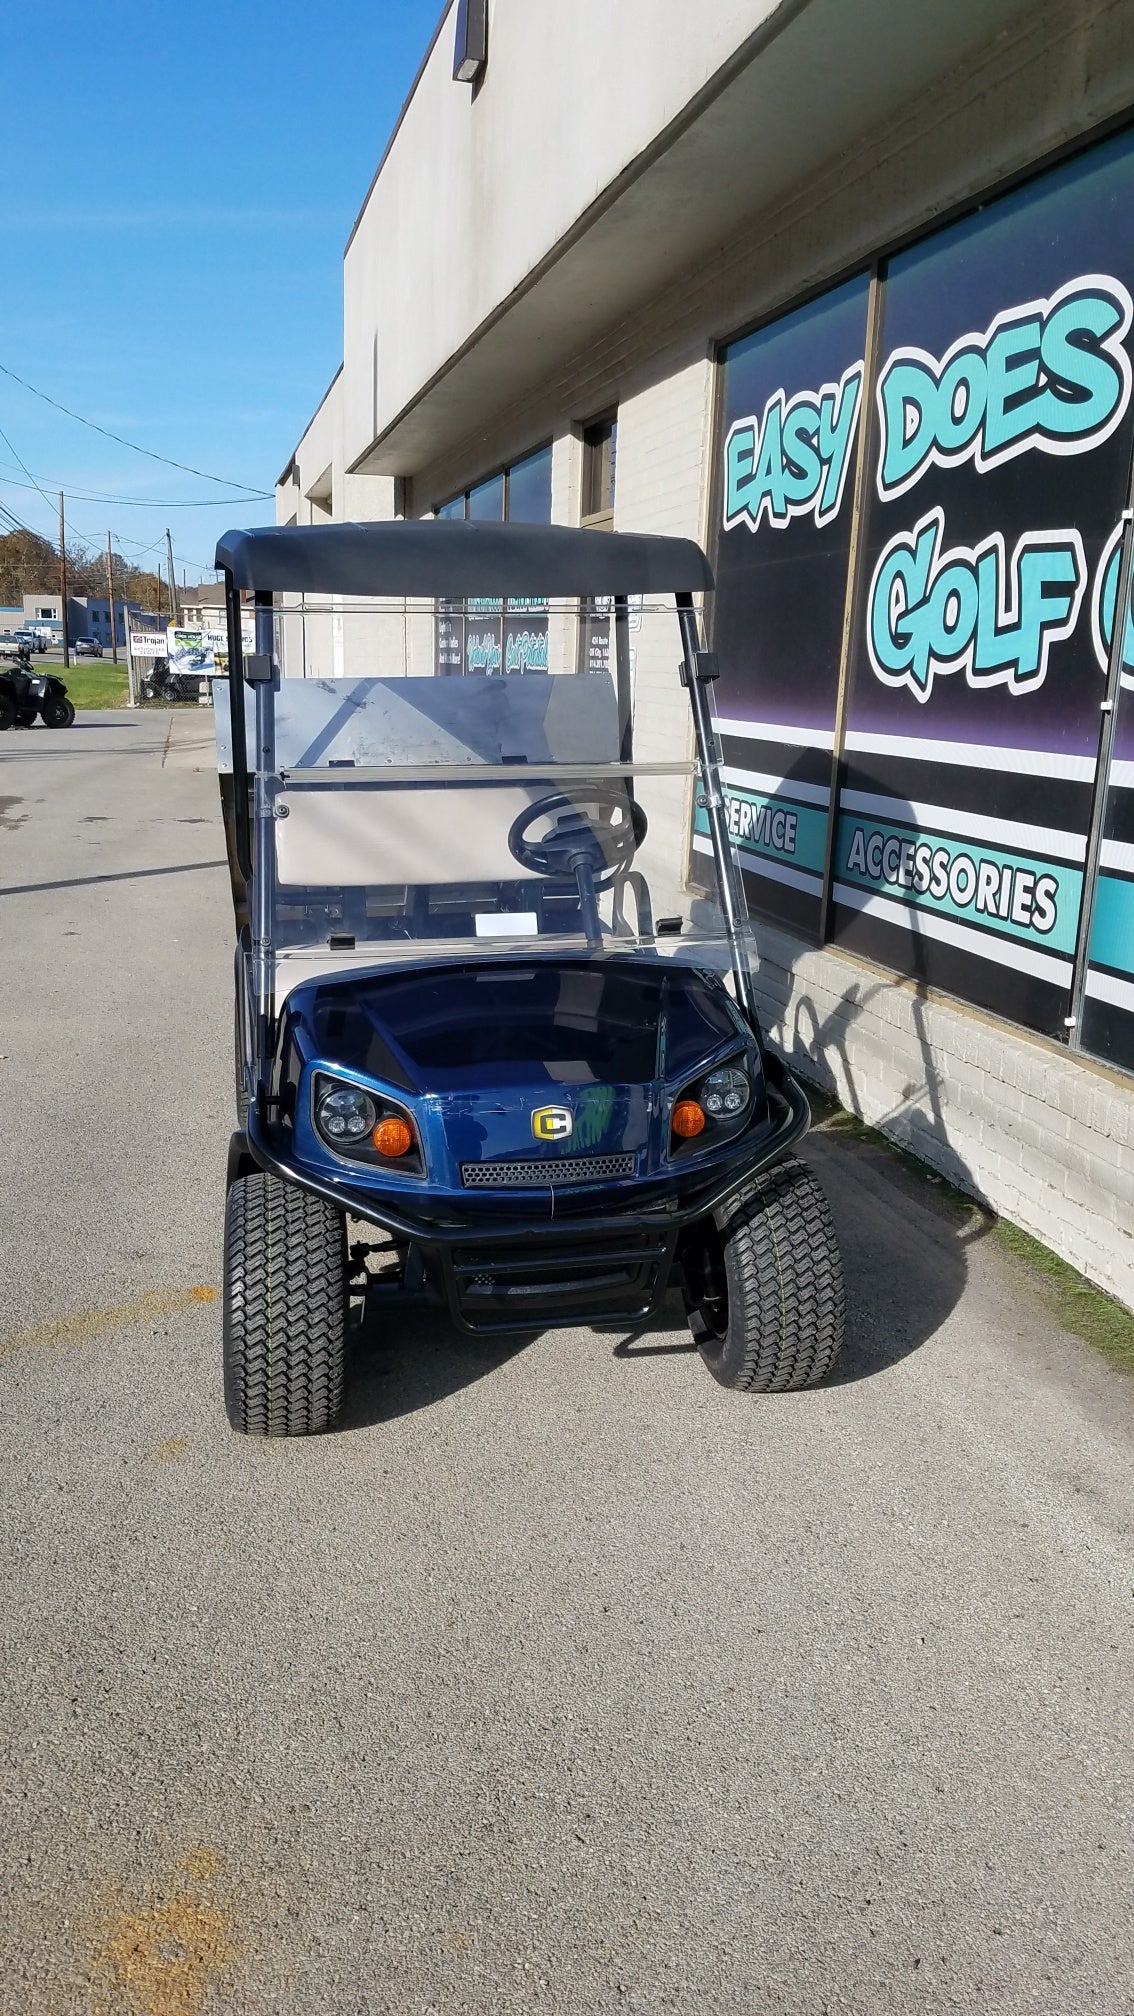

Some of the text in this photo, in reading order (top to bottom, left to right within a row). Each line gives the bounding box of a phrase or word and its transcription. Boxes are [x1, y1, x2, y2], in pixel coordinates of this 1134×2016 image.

[724, 274, 1133, 532] EASY DOES
[143, 636, 165, 646] Trojan
[867, 507, 1087, 703] GOLF
[847, 827, 1060, 935] ACCESSORIES
